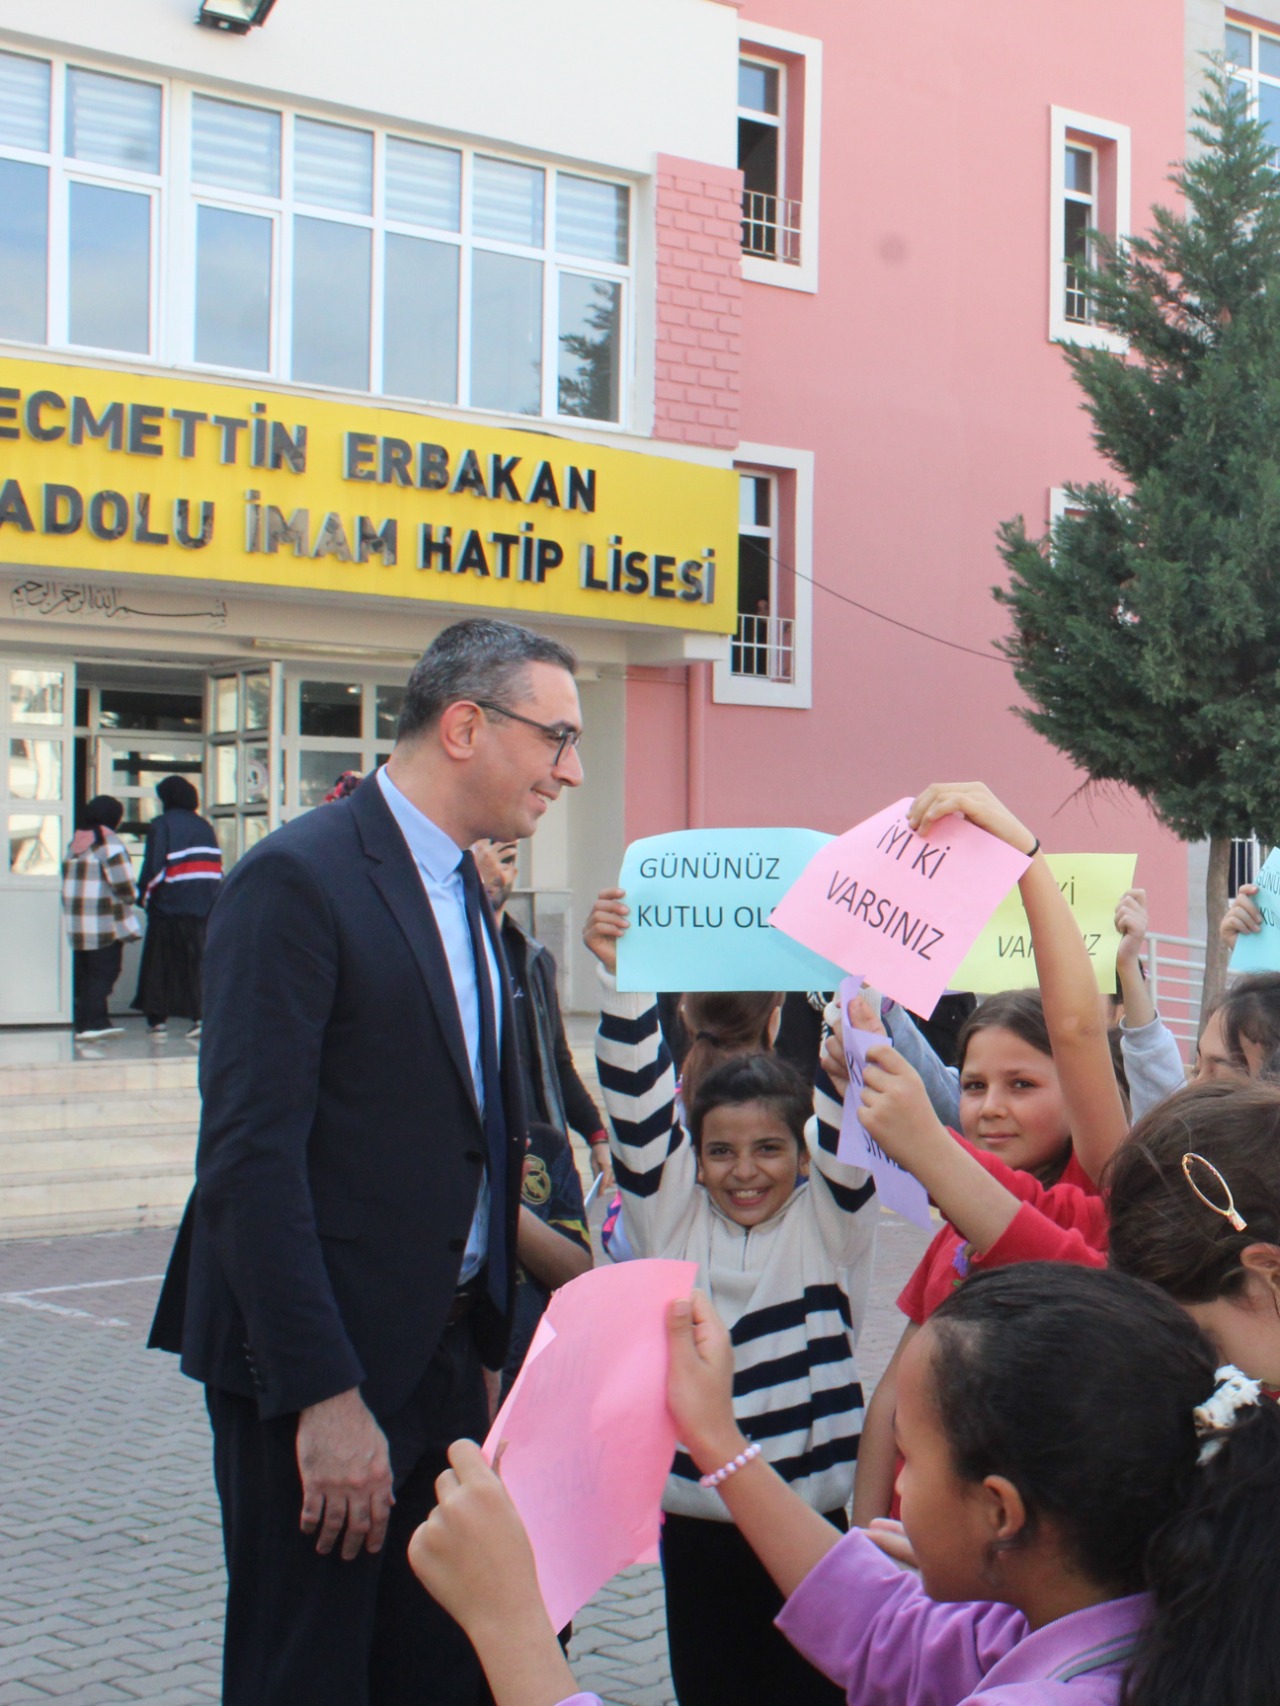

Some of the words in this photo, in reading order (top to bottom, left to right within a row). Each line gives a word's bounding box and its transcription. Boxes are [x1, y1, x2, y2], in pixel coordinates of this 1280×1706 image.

[343, 432, 597, 513] ERBAKAN
[0, 479, 215, 549] ADOLU
[245, 489, 397, 567] İMAM
[417, 522, 564, 583] HATİP
[580, 535, 716, 604] LİSESİ
[640, 852, 780, 880] GÜNÜNÜZ
[911, 843, 951, 880] Kİ
[638, 905, 723, 928] KUTLU
[827, 870, 944, 960] VARSINIZ
